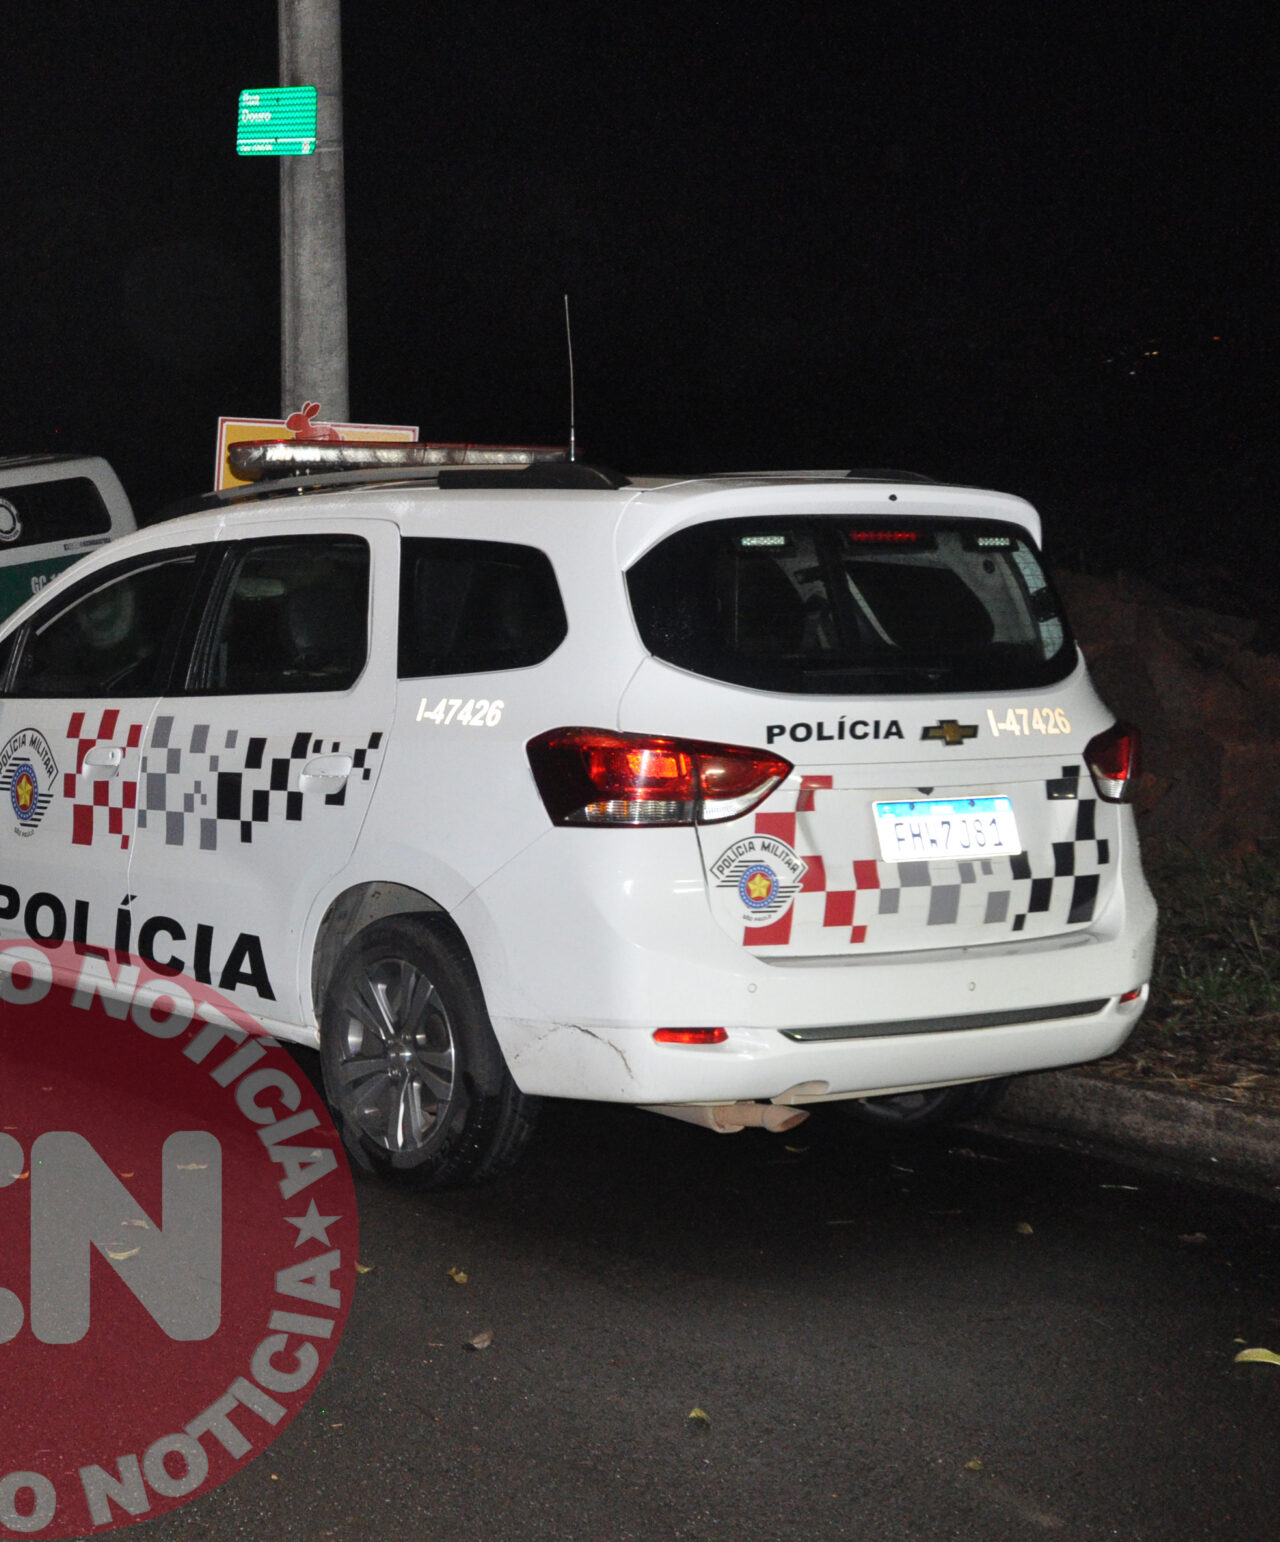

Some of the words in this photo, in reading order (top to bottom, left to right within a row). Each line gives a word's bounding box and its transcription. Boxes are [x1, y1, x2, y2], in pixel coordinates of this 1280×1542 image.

[415, 698, 505, 727] I-47426
[987, 708, 1072, 737] I-47426
[766, 715, 905, 744] POLÍCIA
[29, 734, 54, 778] MILITAR
[716, 841, 756, 876] POLÍCIA
[761, 841, 801, 874] MILITAR
